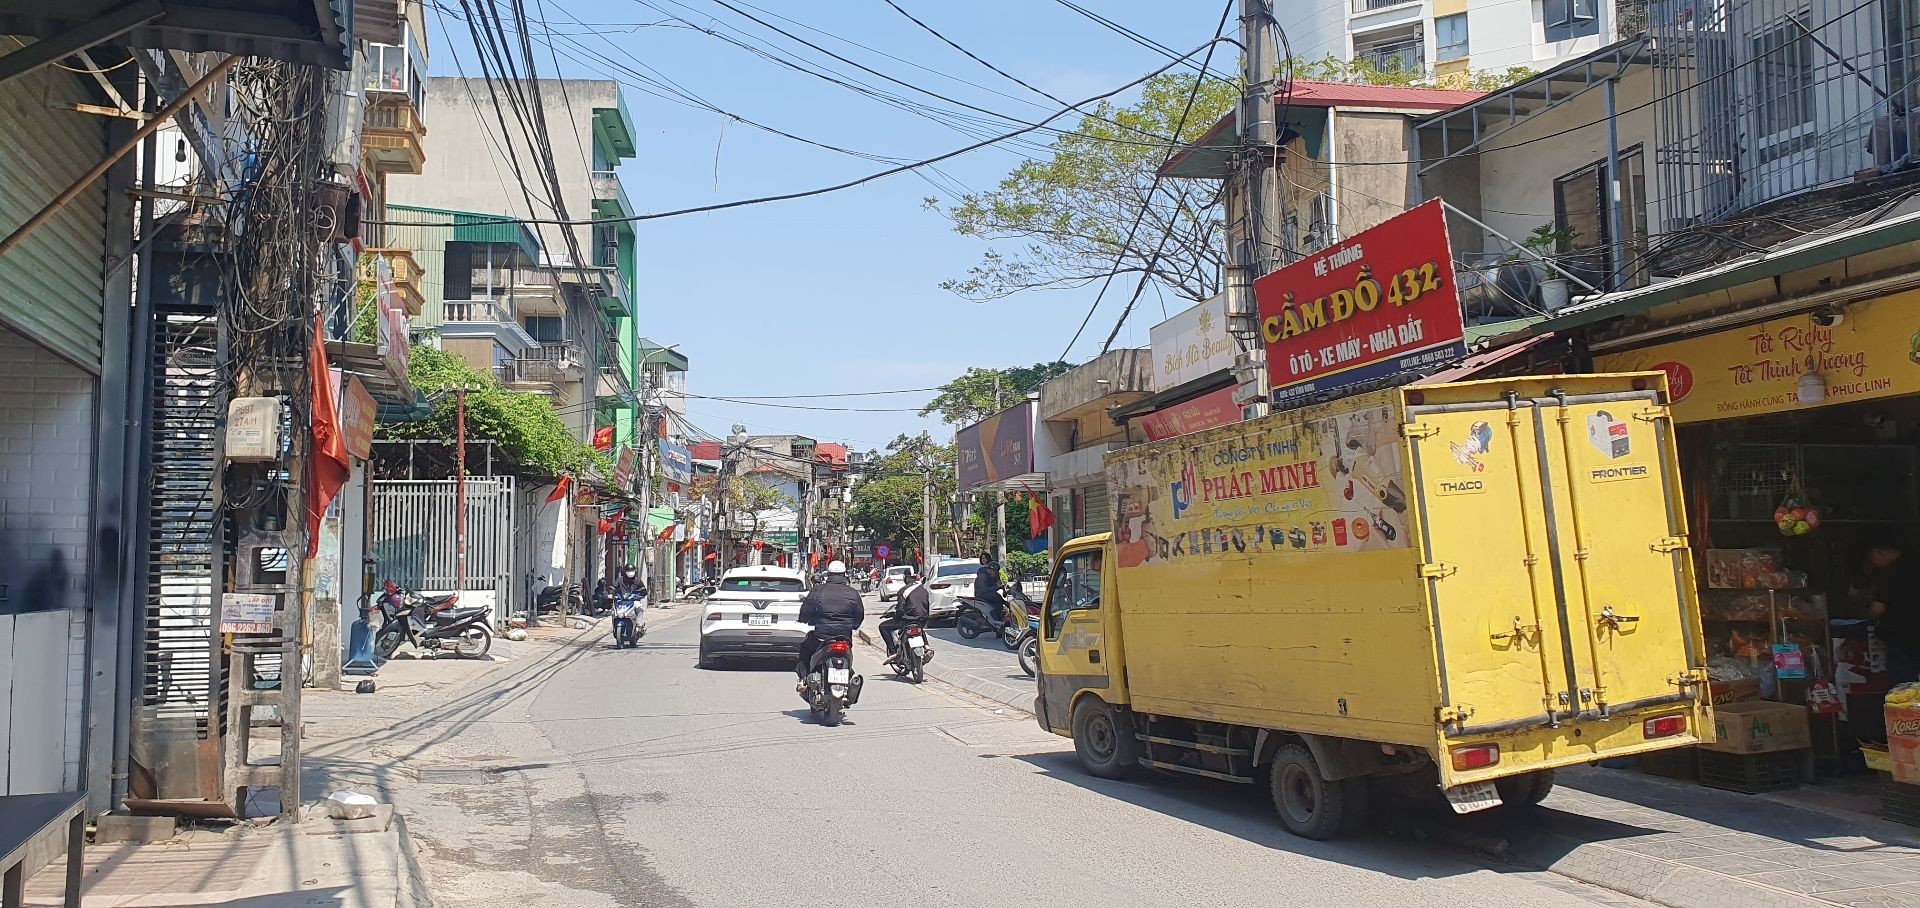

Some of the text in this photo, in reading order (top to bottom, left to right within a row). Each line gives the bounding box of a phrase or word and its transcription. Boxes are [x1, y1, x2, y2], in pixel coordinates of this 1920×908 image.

[1314, 243, 1364, 277] HỆ THỐNG
[1262, 262, 1441, 343] CẦM ĐỒ 432
[1186, 344, 1200, 368] Hà
[1202, 334, 1233, 359] Beauty
[1289, 353, 1298, 375] Ô
[1299, 350, 1312, 372] TÔ
[1319, 347, 1335, 369] XE
[1336, 335, 1361, 363] MÁY
[1368, 324, 1397, 353] NHÀ
[1398, 313, 1424, 345] ĐẤT
[1747, 325, 1835, 355] Tết Richy
[1727, 363, 1752, 385] Tết
[1753, 357, 1801, 382] Thịnh
[1762, 394, 1785, 408] CÙNG
[1832, 380, 1863, 398] PHÚC
[1865, 377, 1891, 393] LINH
[1213, 448, 1247, 467] CÔNG
[1267, 439, 1299, 458] TNHH
[1203, 460, 1320, 502] PHÁT MINH
[1440, 480, 1483, 492] THACO
[1591, 465, 1647, 480] FRONTIER
